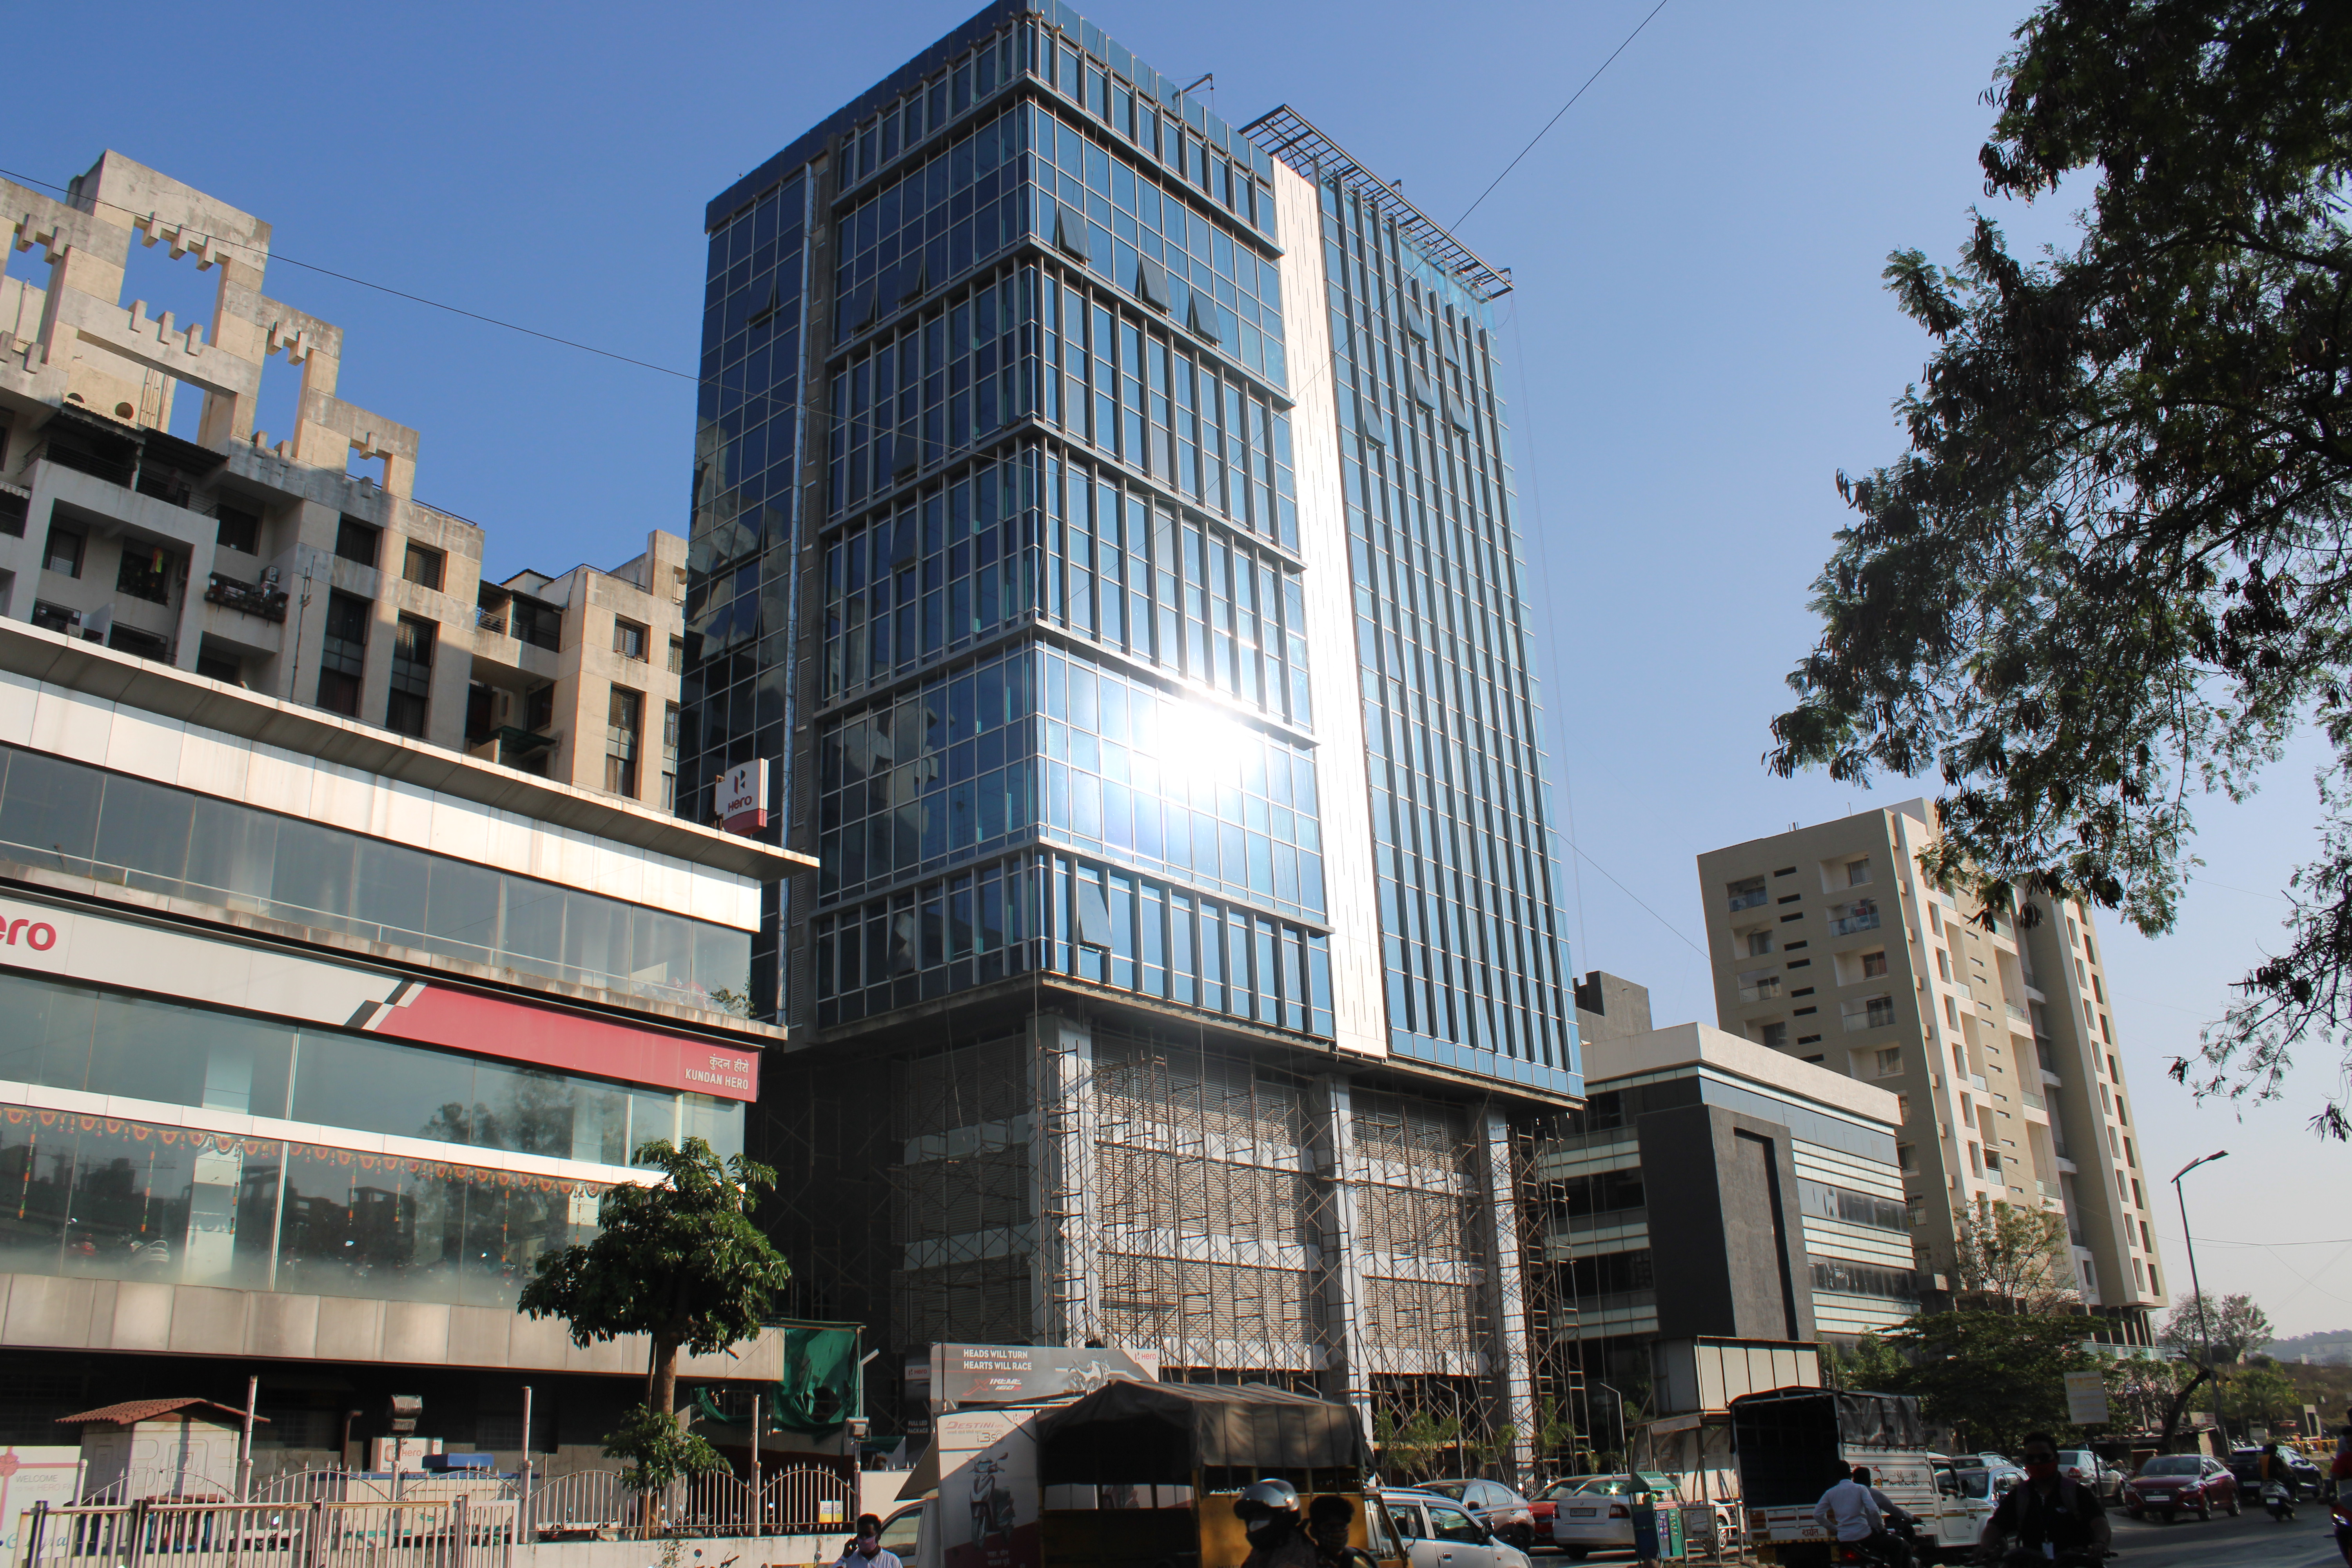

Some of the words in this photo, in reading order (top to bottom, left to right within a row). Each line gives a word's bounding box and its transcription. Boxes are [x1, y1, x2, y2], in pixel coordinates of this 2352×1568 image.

[728, 795, 752, 813] Hero
[0, 915, 56, 951] ro
[709, 1053, 730, 1070] कुंदन
[734, 1058, 749, 1073] हीरो
[685, 1068, 722, 1085] KUNDAN
[725, 1076, 748, 1090] HERO
[964, 1349, 989, 1358] HEADS
[990, 1350, 1007, 1358] WILL
[1008, 1350, 1028, 1359] TURN
[964, 1361, 993, 1370] HEARTS
[994, 1361, 1011, 1370] WILL
[1012, 1362, 1032, 1370] RACE
[16, 1474, 58, 1483] WELCOME
